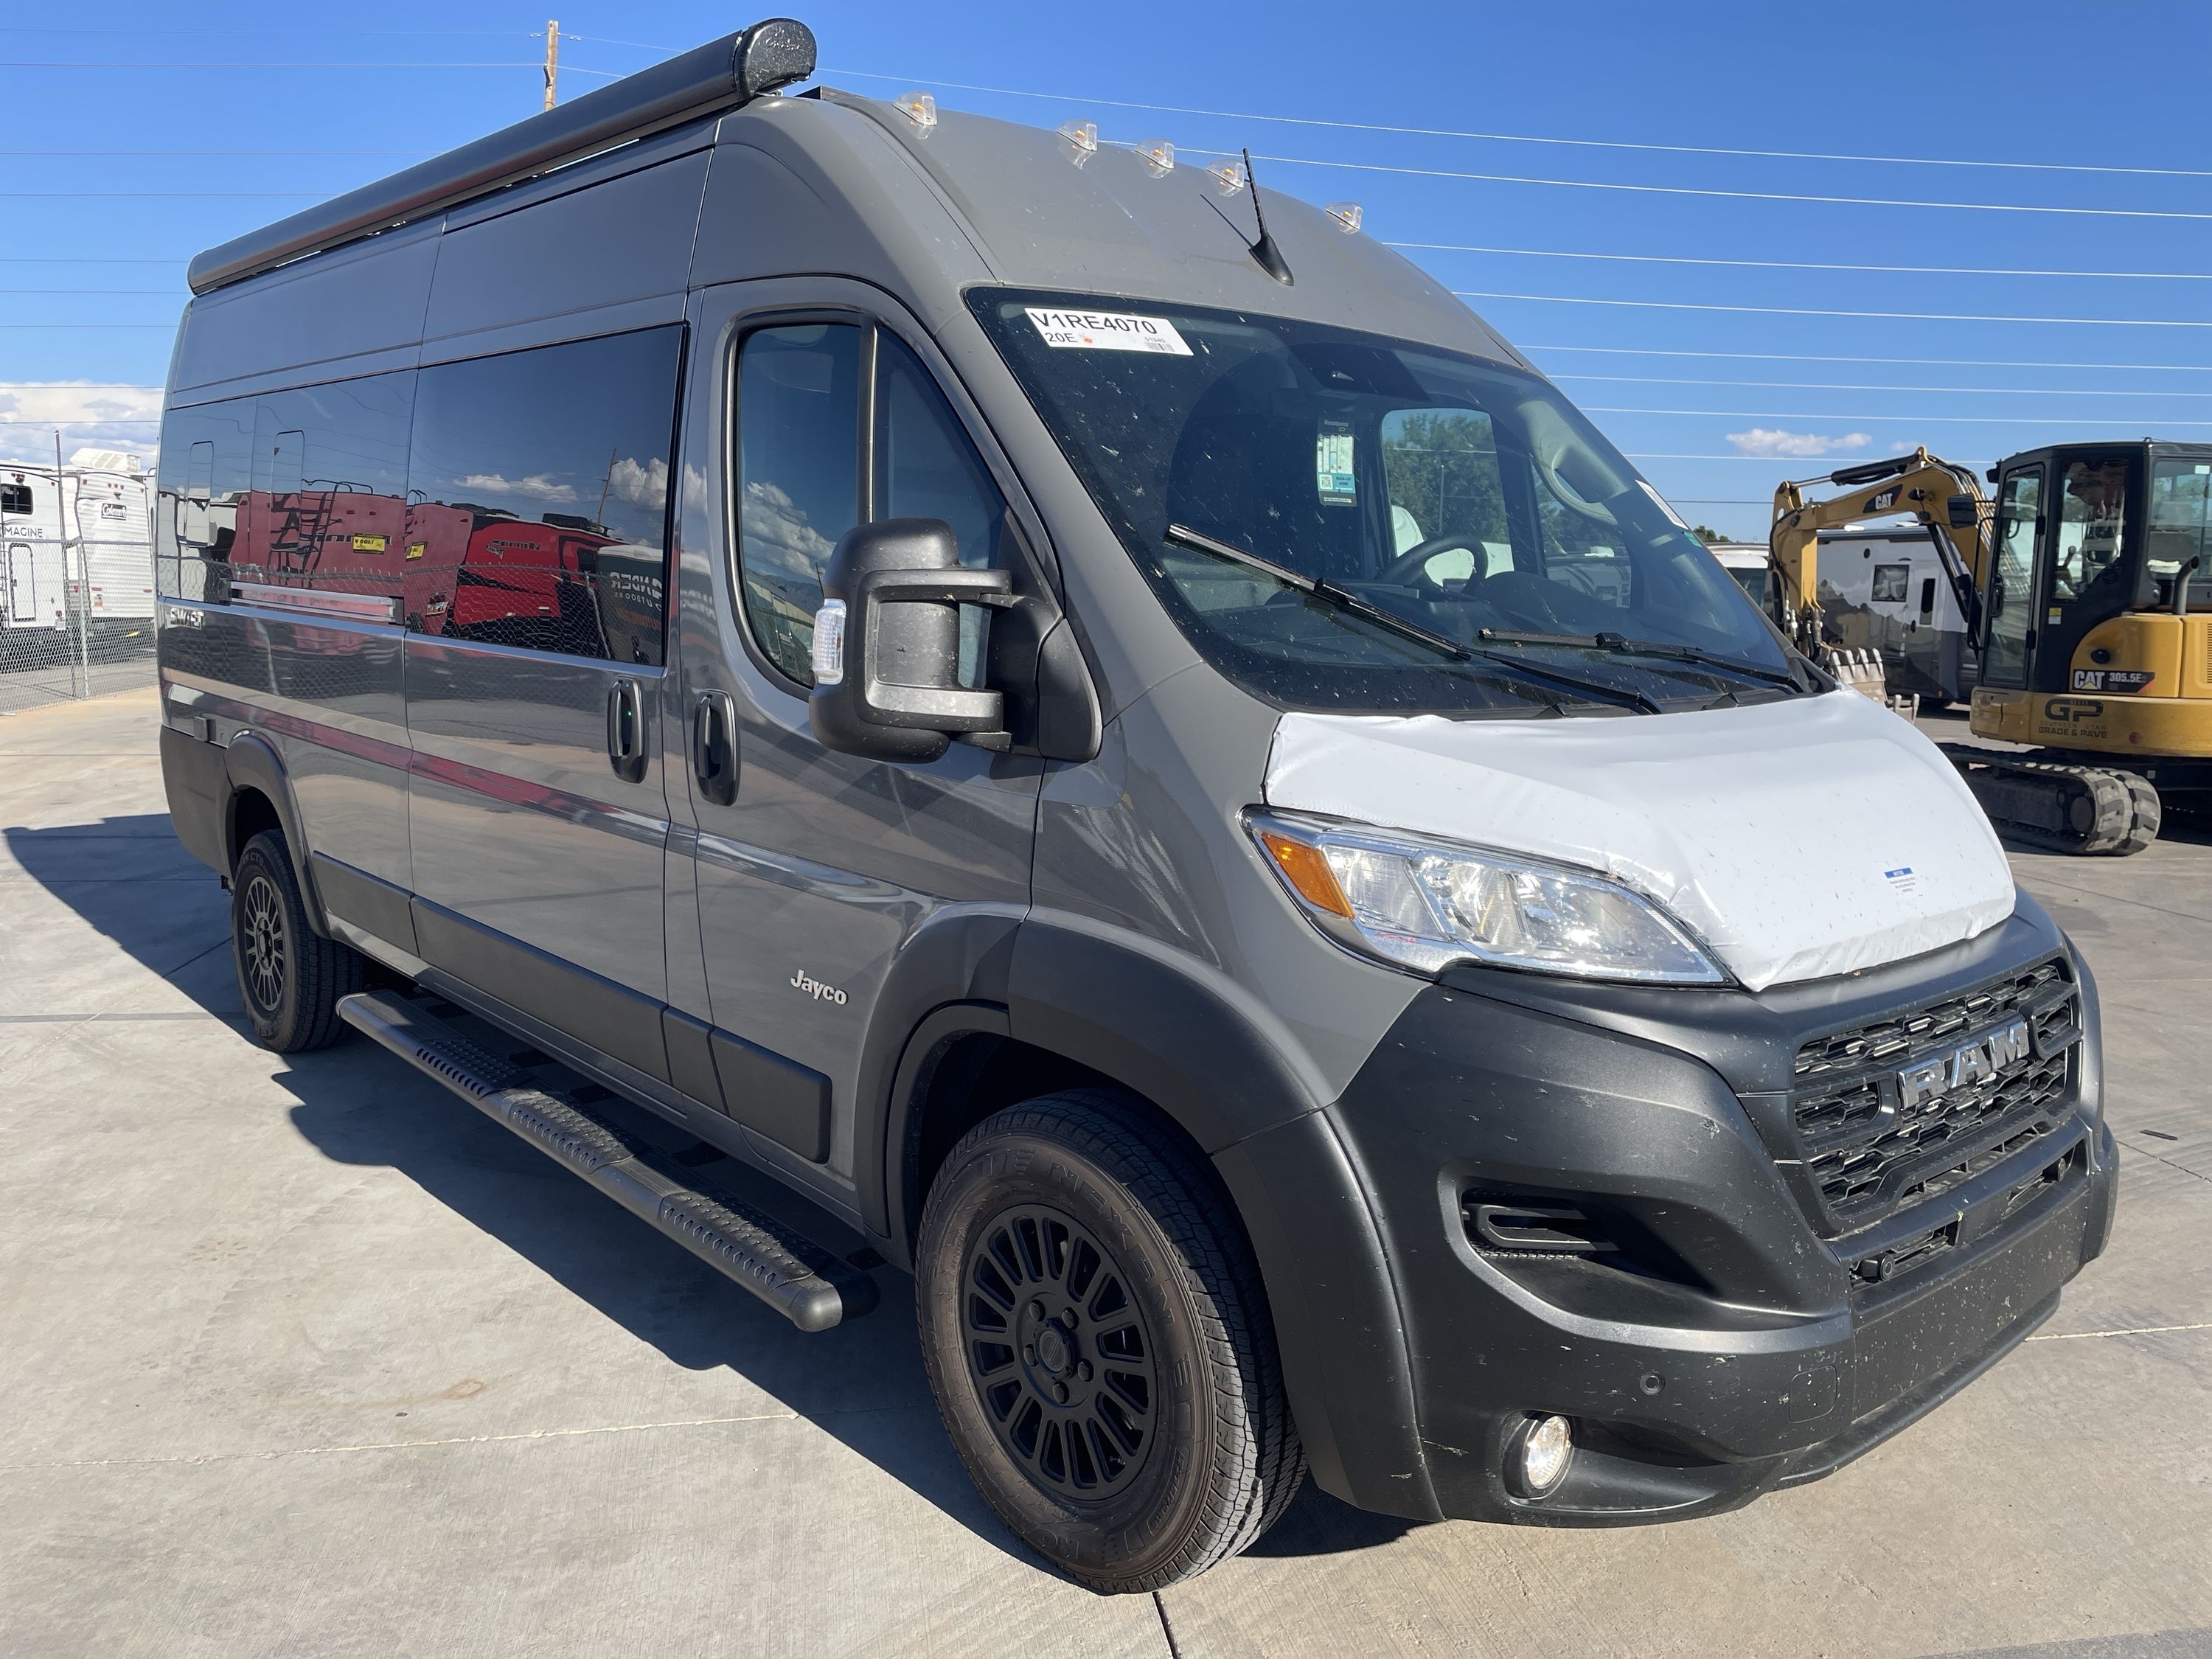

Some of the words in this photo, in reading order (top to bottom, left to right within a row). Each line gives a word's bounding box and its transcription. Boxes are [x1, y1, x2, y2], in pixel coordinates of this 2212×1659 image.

[1029, 312, 1158, 335] V1RE4070
[1045, 332, 1079, 343] 20E
[1875, 493, 1893, 510] CAT
[2, 526, 44, 538] MAGINE
[2074, 670, 2105, 690] CAT
[2045, 698, 2104, 722] GP
[2038, 726, 2070, 736] GRADE
[2080, 729, 2108, 739] PAVE
[790, 968, 849, 1006] Jayco
[1898, 1020, 2030, 1111] RAM
[1051, 1161, 1175, 1325] NEXEN
